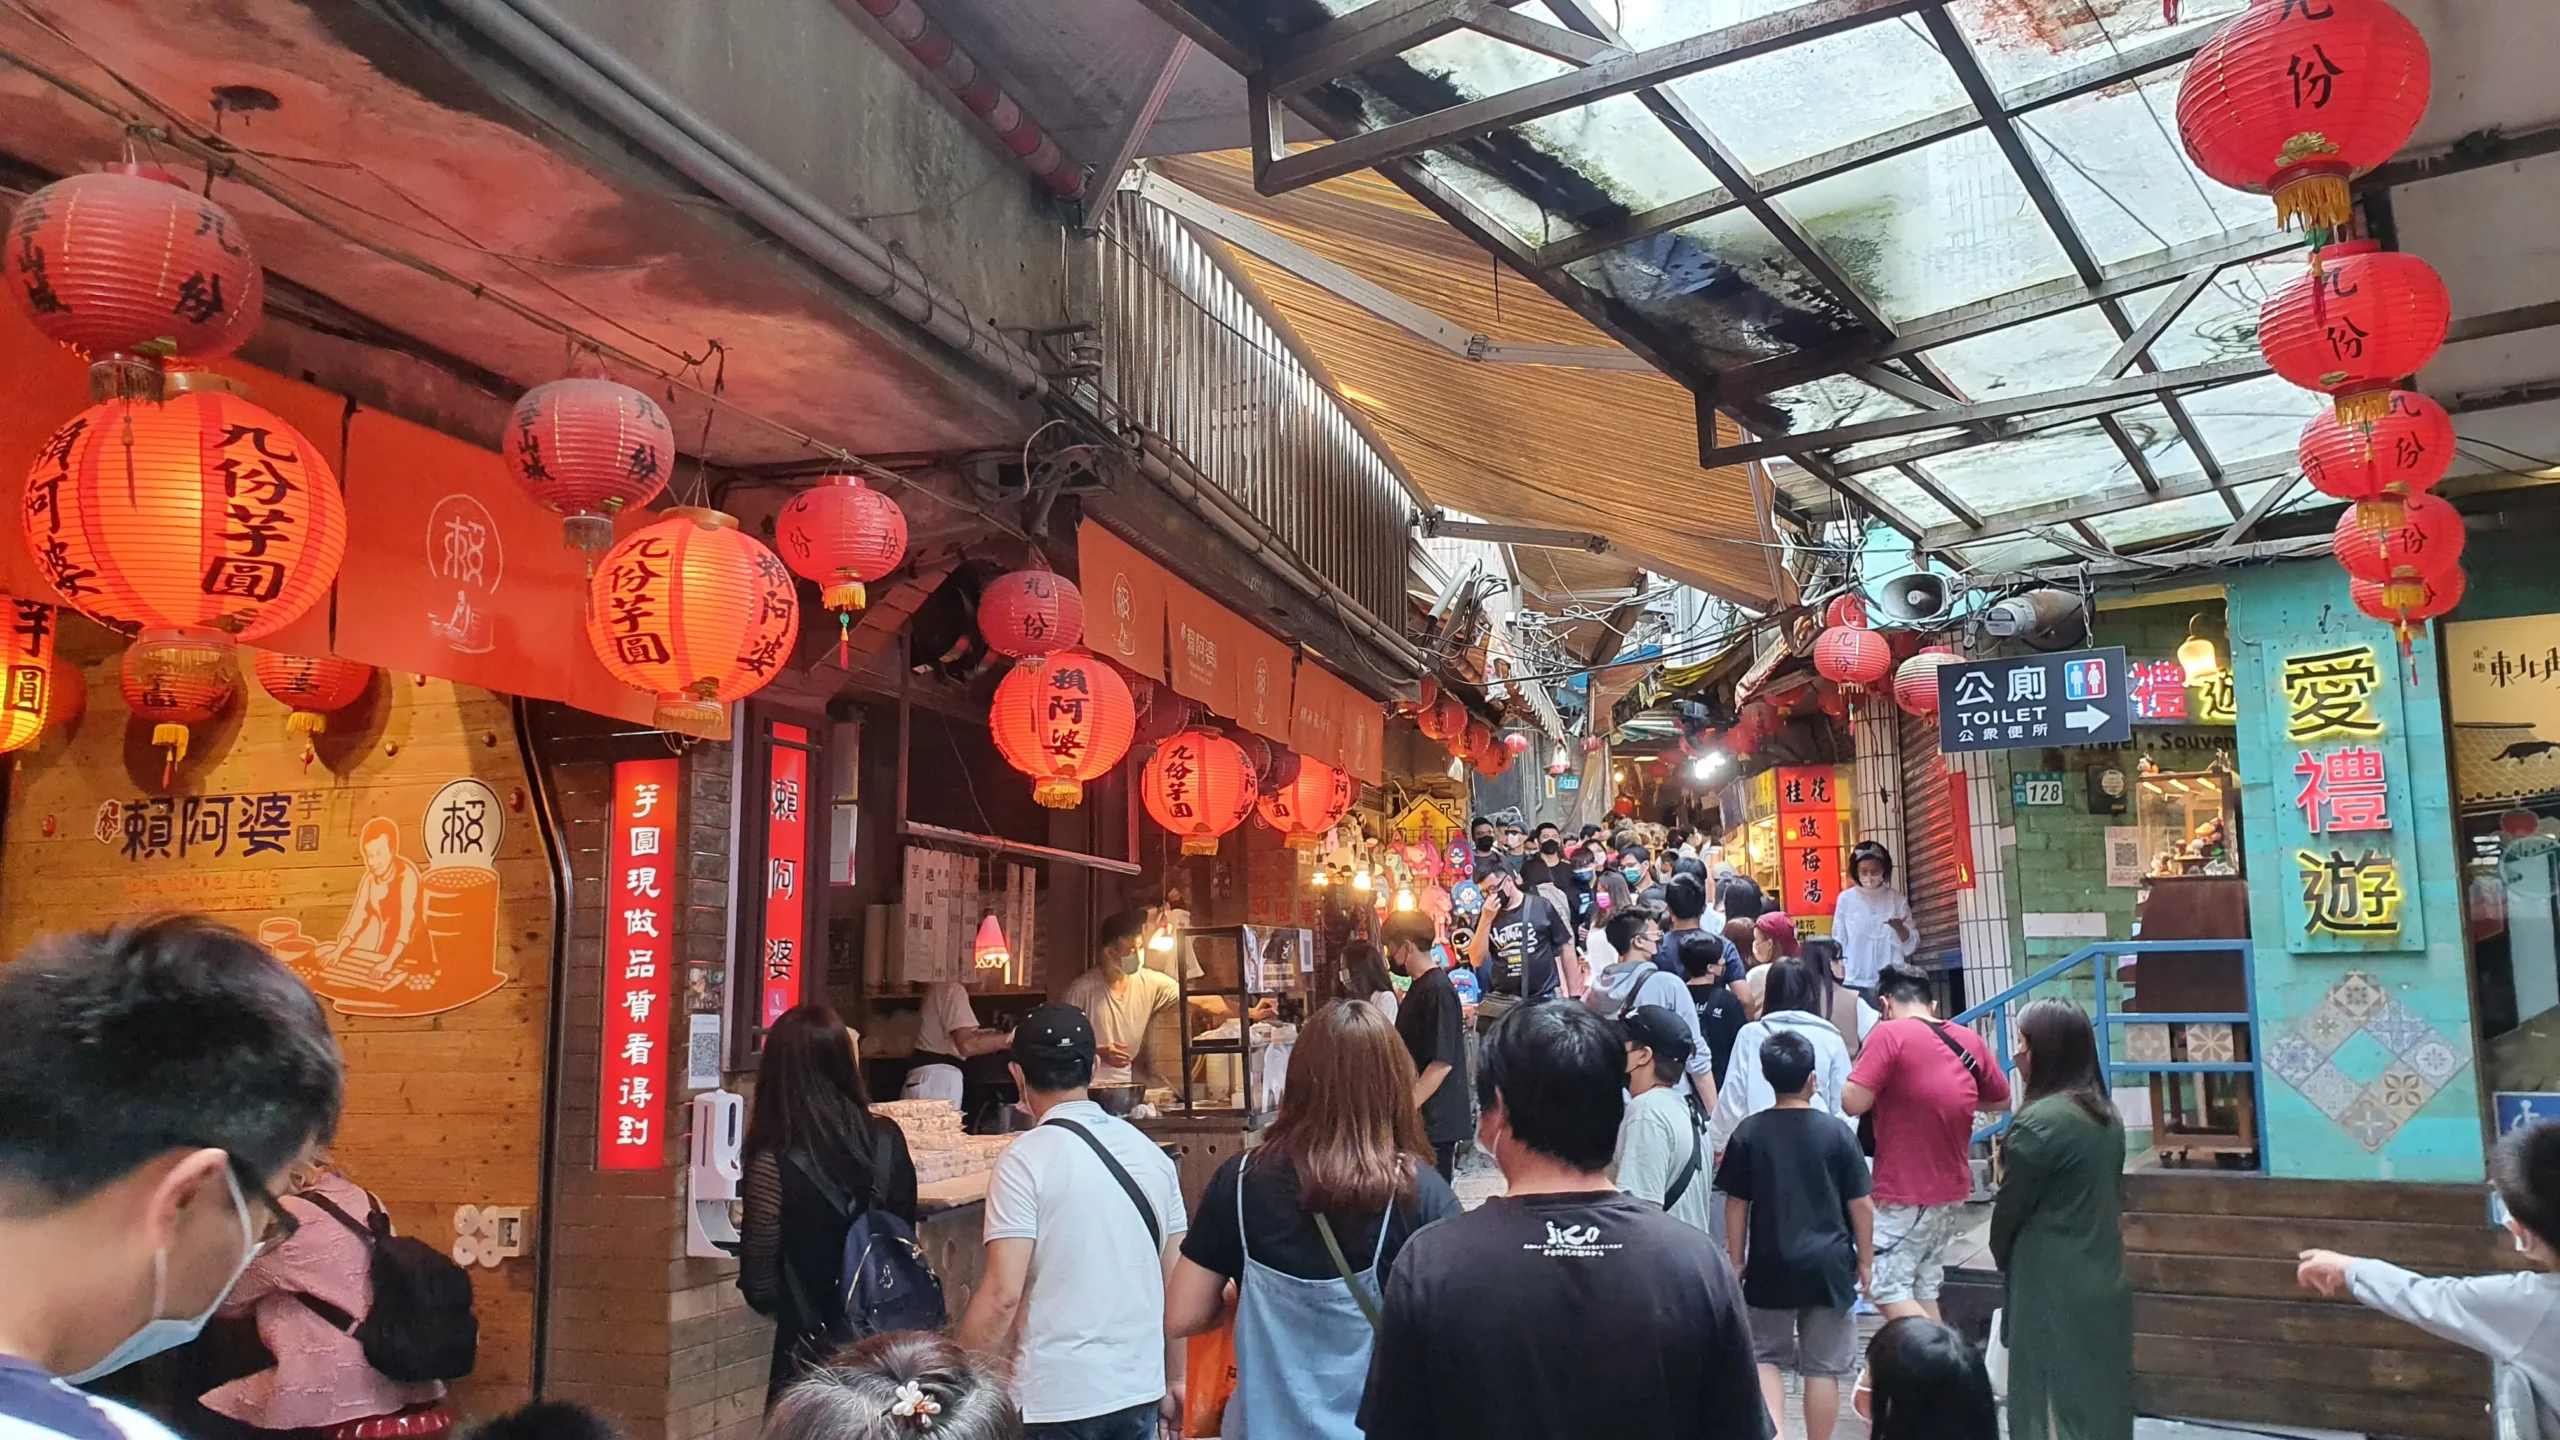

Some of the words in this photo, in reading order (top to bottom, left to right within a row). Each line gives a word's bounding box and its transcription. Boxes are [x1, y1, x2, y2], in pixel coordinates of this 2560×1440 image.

[2280, 0, 2344, 110] 九份
[2322, 266, 2369, 361] 九份
[2390, 394, 2426, 469] 九份
[200, 424, 300, 602] 九份芋圓
[786, 492, 813, 559] 九份
[610, 536, 671, 666] 九份芋圓
[735, 549, 797, 678] 賴阿婆
[1023, 578, 1050, 640] 九份
[7, 599, 50, 714] 芋圓
[1834, 632, 1853, 673] 九份
[1955, 665, 2046, 706] 公廁
[1042, 668, 1090, 759] 賴阿婆
[1957, 706, 2048, 727] TOILET
[1164, 744, 1195, 819] 九份芋圓
[1785, 777, 1832, 804] 桂花
[2029, 783, 2060, 802] 128
[2280, 645, 2401, 935] 愛禮遊
[120, 792, 293, 862] 賴阿婆
[295, 791, 325, 852] 芋圓
[1799, 815, 1822, 904] 酸梅湯
[766, 779, 799, 981] 賴阿婆
[615, 783, 661, 1146] 芋圓現做品質看得到
